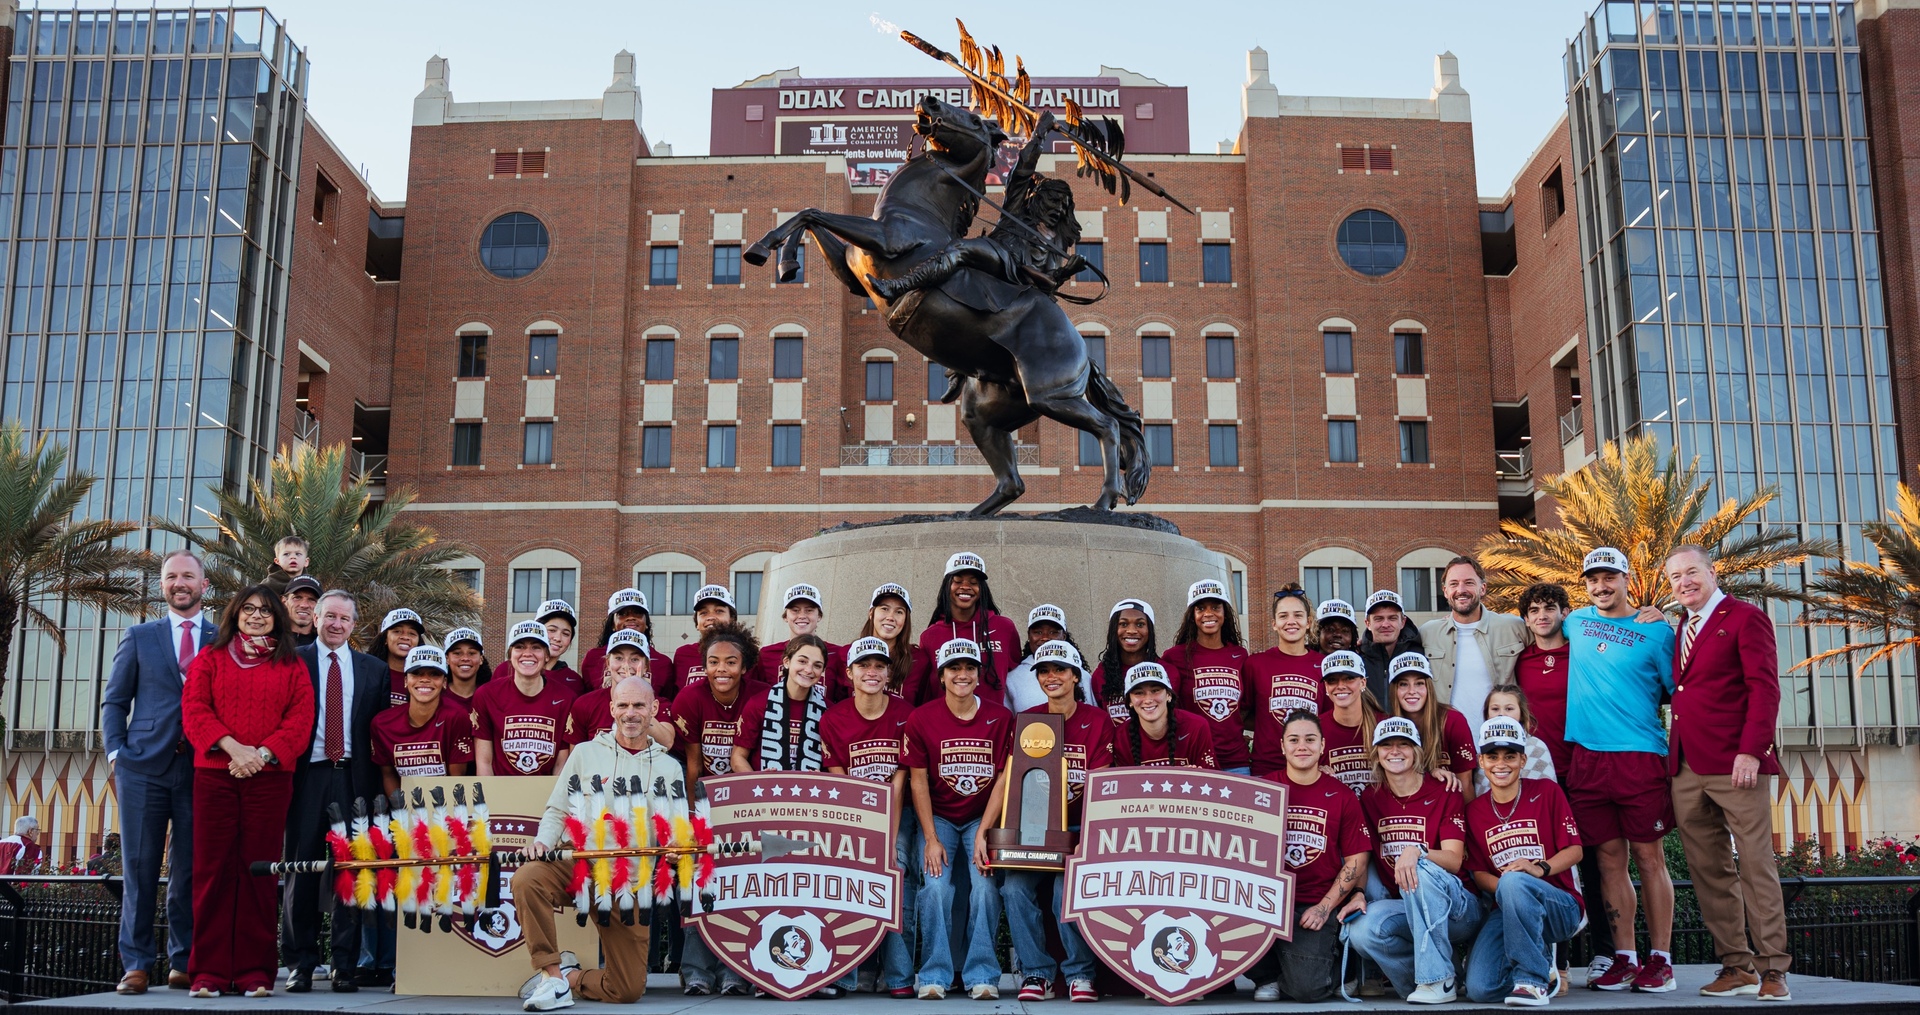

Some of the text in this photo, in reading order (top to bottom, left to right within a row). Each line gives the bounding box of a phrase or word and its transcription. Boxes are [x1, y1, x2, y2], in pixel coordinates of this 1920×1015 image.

[779, 89, 845, 109] DOAK
[1009, 88, 1120, 107] TADIUM
[867, 149, 884, 159] love
[885, 149, 907, 160] living
[787, 590, 816, 600] CHAMPIONS
[1192, 587, 1222, 598] CHAMPIONS
[615, 596, 644, 605] CHAMPIONS
[1031, 611, 1061, 620] CHAMPIONS
[1322, 607, 1351, 617] CHAMPIONS
[514, 628, 545, 638] CHAMPIONS
[1579, 619, 1647, 643] FLORIDA STATE
[450, 633, 479, 642] CHAMPIONS
[612, 636, 644, 647] CHAMPIONS
[1582, 628, 1634, 647] SEMINOLES
[856, 644, 887, 655] CHAMPIONS
[945, 647, 977, 657] CHAMPIONS
[1036, 649, 1067, 659] CHAMPIONS
[411, 654, 442, 665] CHAMPIONS
[1323, 659, 1354, 672] CHAMPIONS
[1393, 661, 1424, 673] CHAMPIONS
[1130, 671, 1163, 683] CHAMPIONS
[1198, 678, 1239, 688] NATIONAL
[1196, 689, 1240, 700] CHAMPIONS
[1274, 688, 1316, 701] NATIONAL
[507, 730, 551, 741] NATIONAL
[1380, 727, 1412, 737] CHAMPIONS
[1484, 730, 1518, 740] CHAMPIONS
[503, 741, 553, 752] CHAMPIONS
[1022, 739, 1053, 749] NCAA
[397, 756, 440, 766] NATIONAL
[853, 754, 897, 766] NATIONAL
[944, 754, 990, 763] NATIONAL
[941, 765, 992, 775] CHAMPIONS
[714, 786, 878, 807] 20 25
[1101, 780, 1271, 808] 20 25
[770, 807, 819, 818] WOMEN'S
[822, 809, 862, 823] SOCCER
[1158, 804, 1209, 816] WOMEN'S
[1212, 808, 1254, 824] SOCCER
[1288, 821, 1322, 834] TIONAL
[502, 837, 527, 845] SOCCER
[1381, 831, 1422, 842] NATIONAL
[1097, 826, 1268, 868] NATIONAL
[1491, 836, 1537, 853] NATIONAL
[1001, 851, 1058, 860] NATIONAL CHAMPION
[701, 872, 887, 909] HAMPIONS
[1080, 870, 1277, 914] CHAMPIONS
